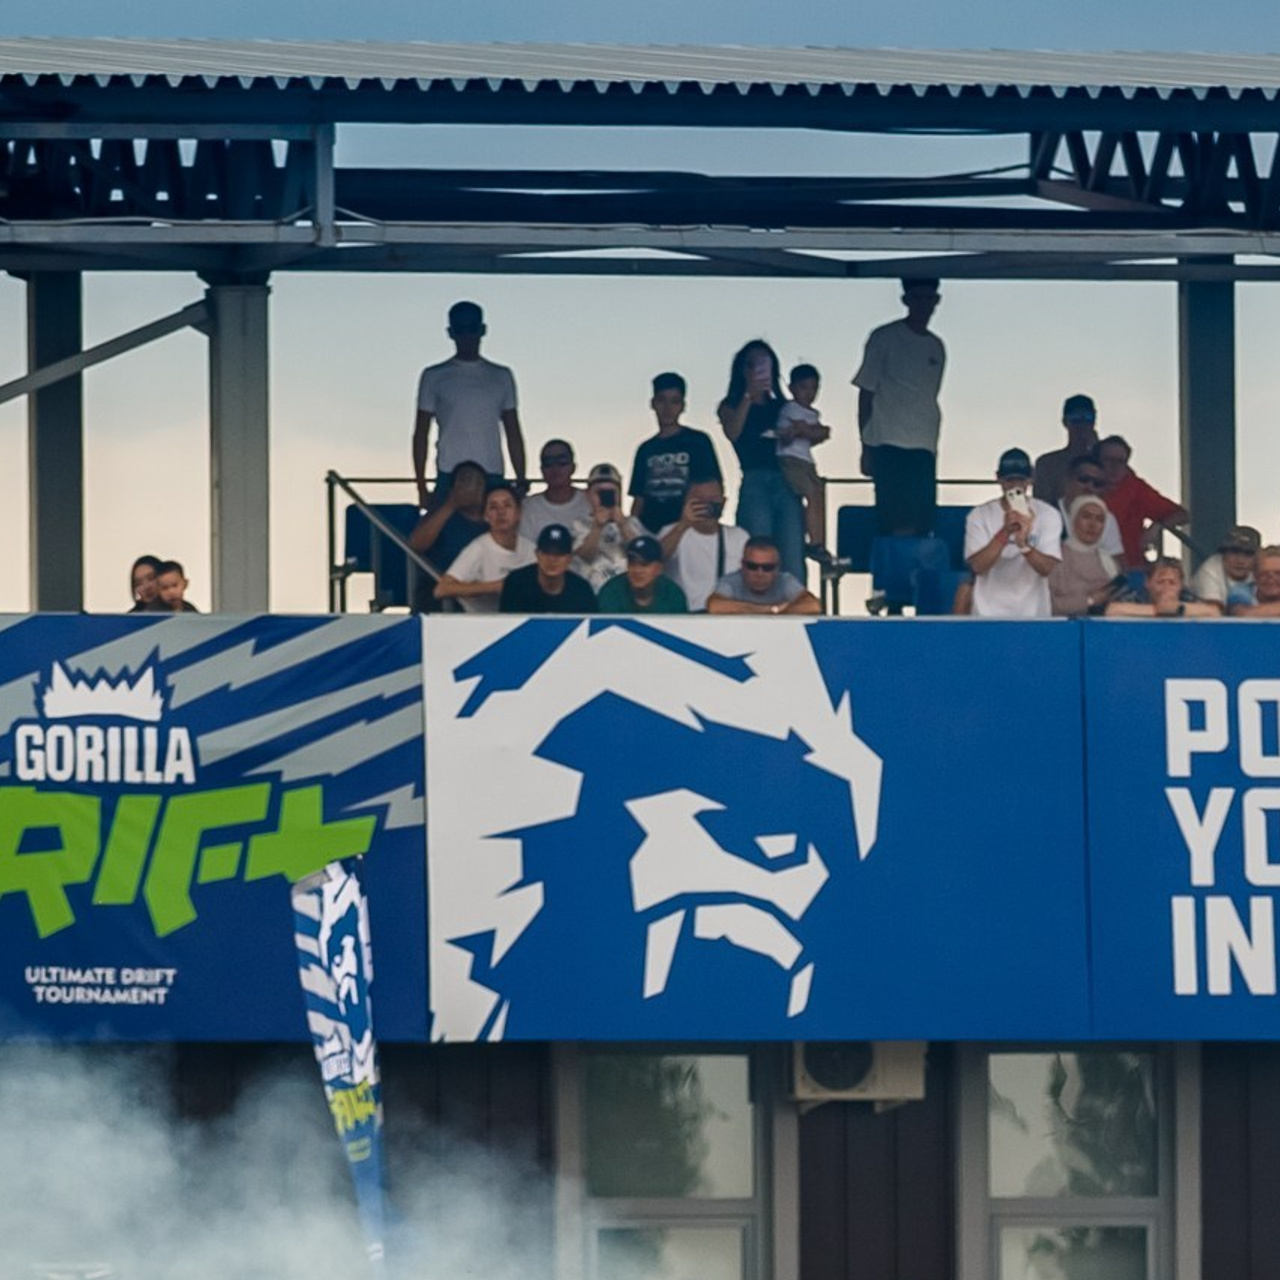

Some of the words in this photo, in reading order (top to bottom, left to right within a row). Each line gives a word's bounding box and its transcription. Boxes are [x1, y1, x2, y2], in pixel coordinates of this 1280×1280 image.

[15, 725, 195, 785] GORILLA
[1171, 896, 1277, 995] IN
[24, 966, 117, 984] ULTIMATE
[120, 968, 177, 985] DRIFT
[33, 985, 169, 1004] TOURNAMENT
